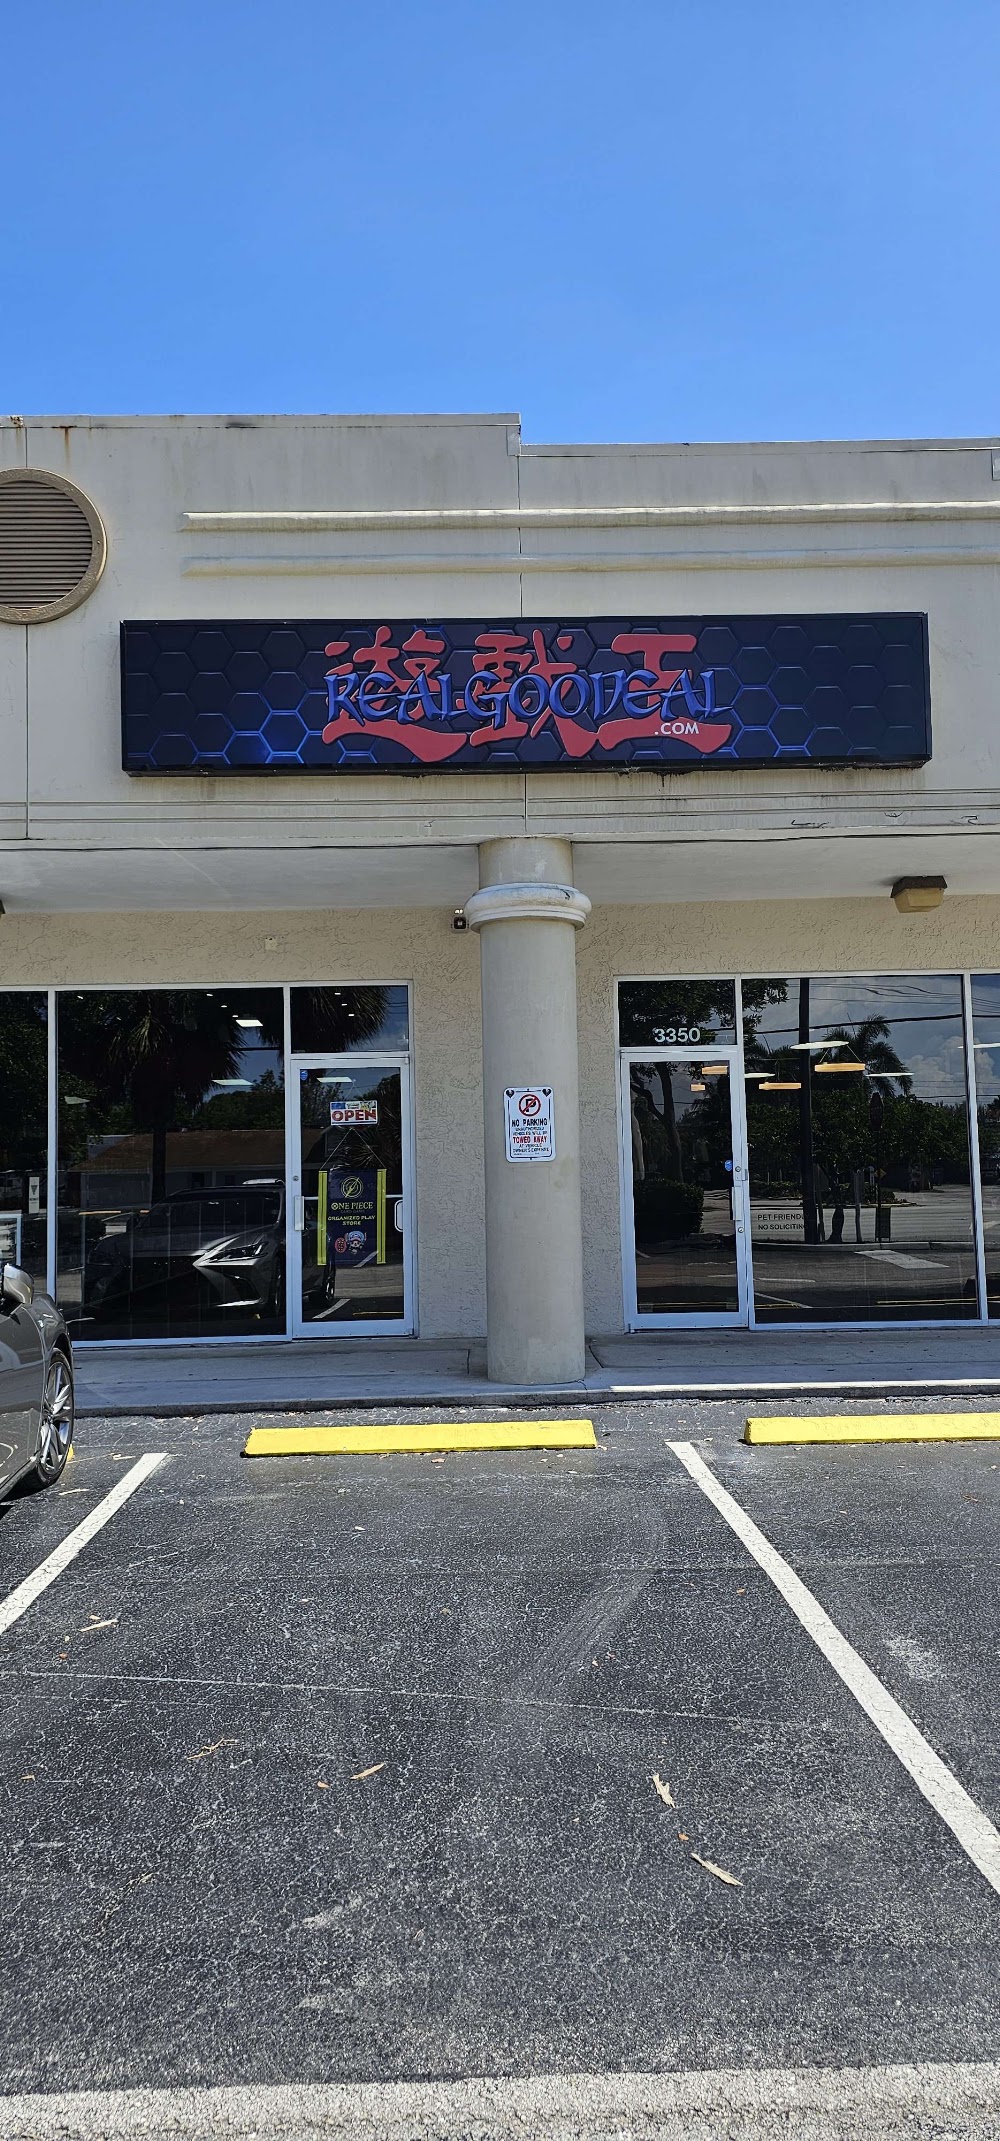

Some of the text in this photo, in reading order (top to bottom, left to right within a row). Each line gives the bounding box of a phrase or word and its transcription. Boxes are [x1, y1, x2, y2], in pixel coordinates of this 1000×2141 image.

[323, 669, 733, 729] REALGOODEAL
[654, 1027, 701, 1043] 3350
[332, 1109, 377, 1122] OPEN
[511, 1118, 548, 1127] NO PARKING
[331, 1201, 374, 1210] ONE PIECE
